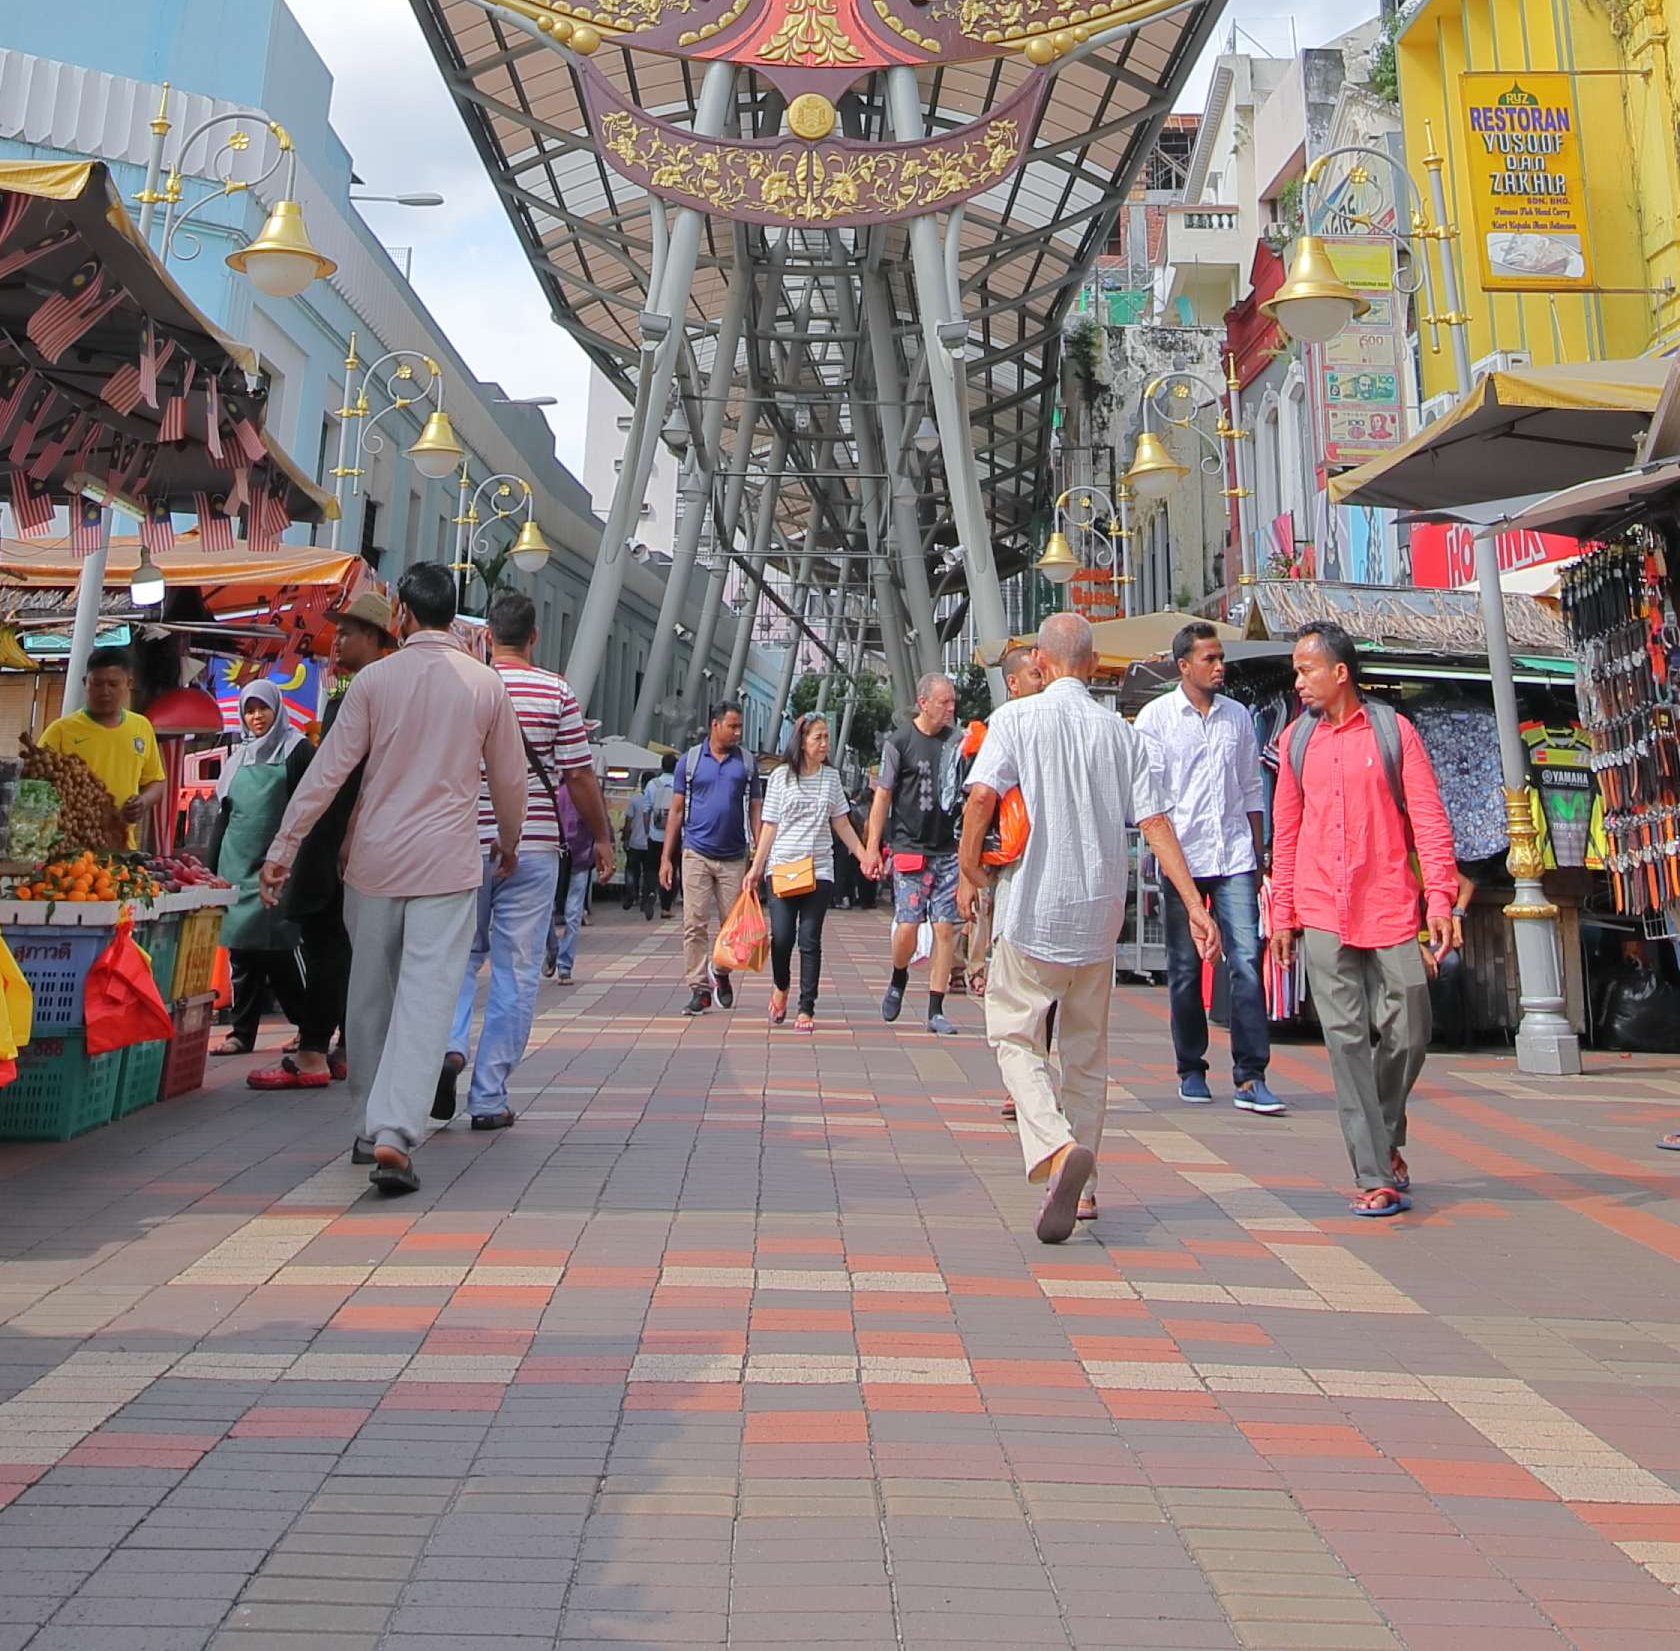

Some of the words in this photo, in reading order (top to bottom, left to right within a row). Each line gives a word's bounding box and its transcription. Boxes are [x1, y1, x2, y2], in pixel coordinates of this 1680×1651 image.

[1469, 106, 1570, 132] RESTORAN
[1483, 131, 1565, 154] YUSOOF
[1505, 155, 1546, 171] DAN
[1490, 170, 1567, 196] ZAKHIR
[1552, 770, 1590, 784] YAMAHA
